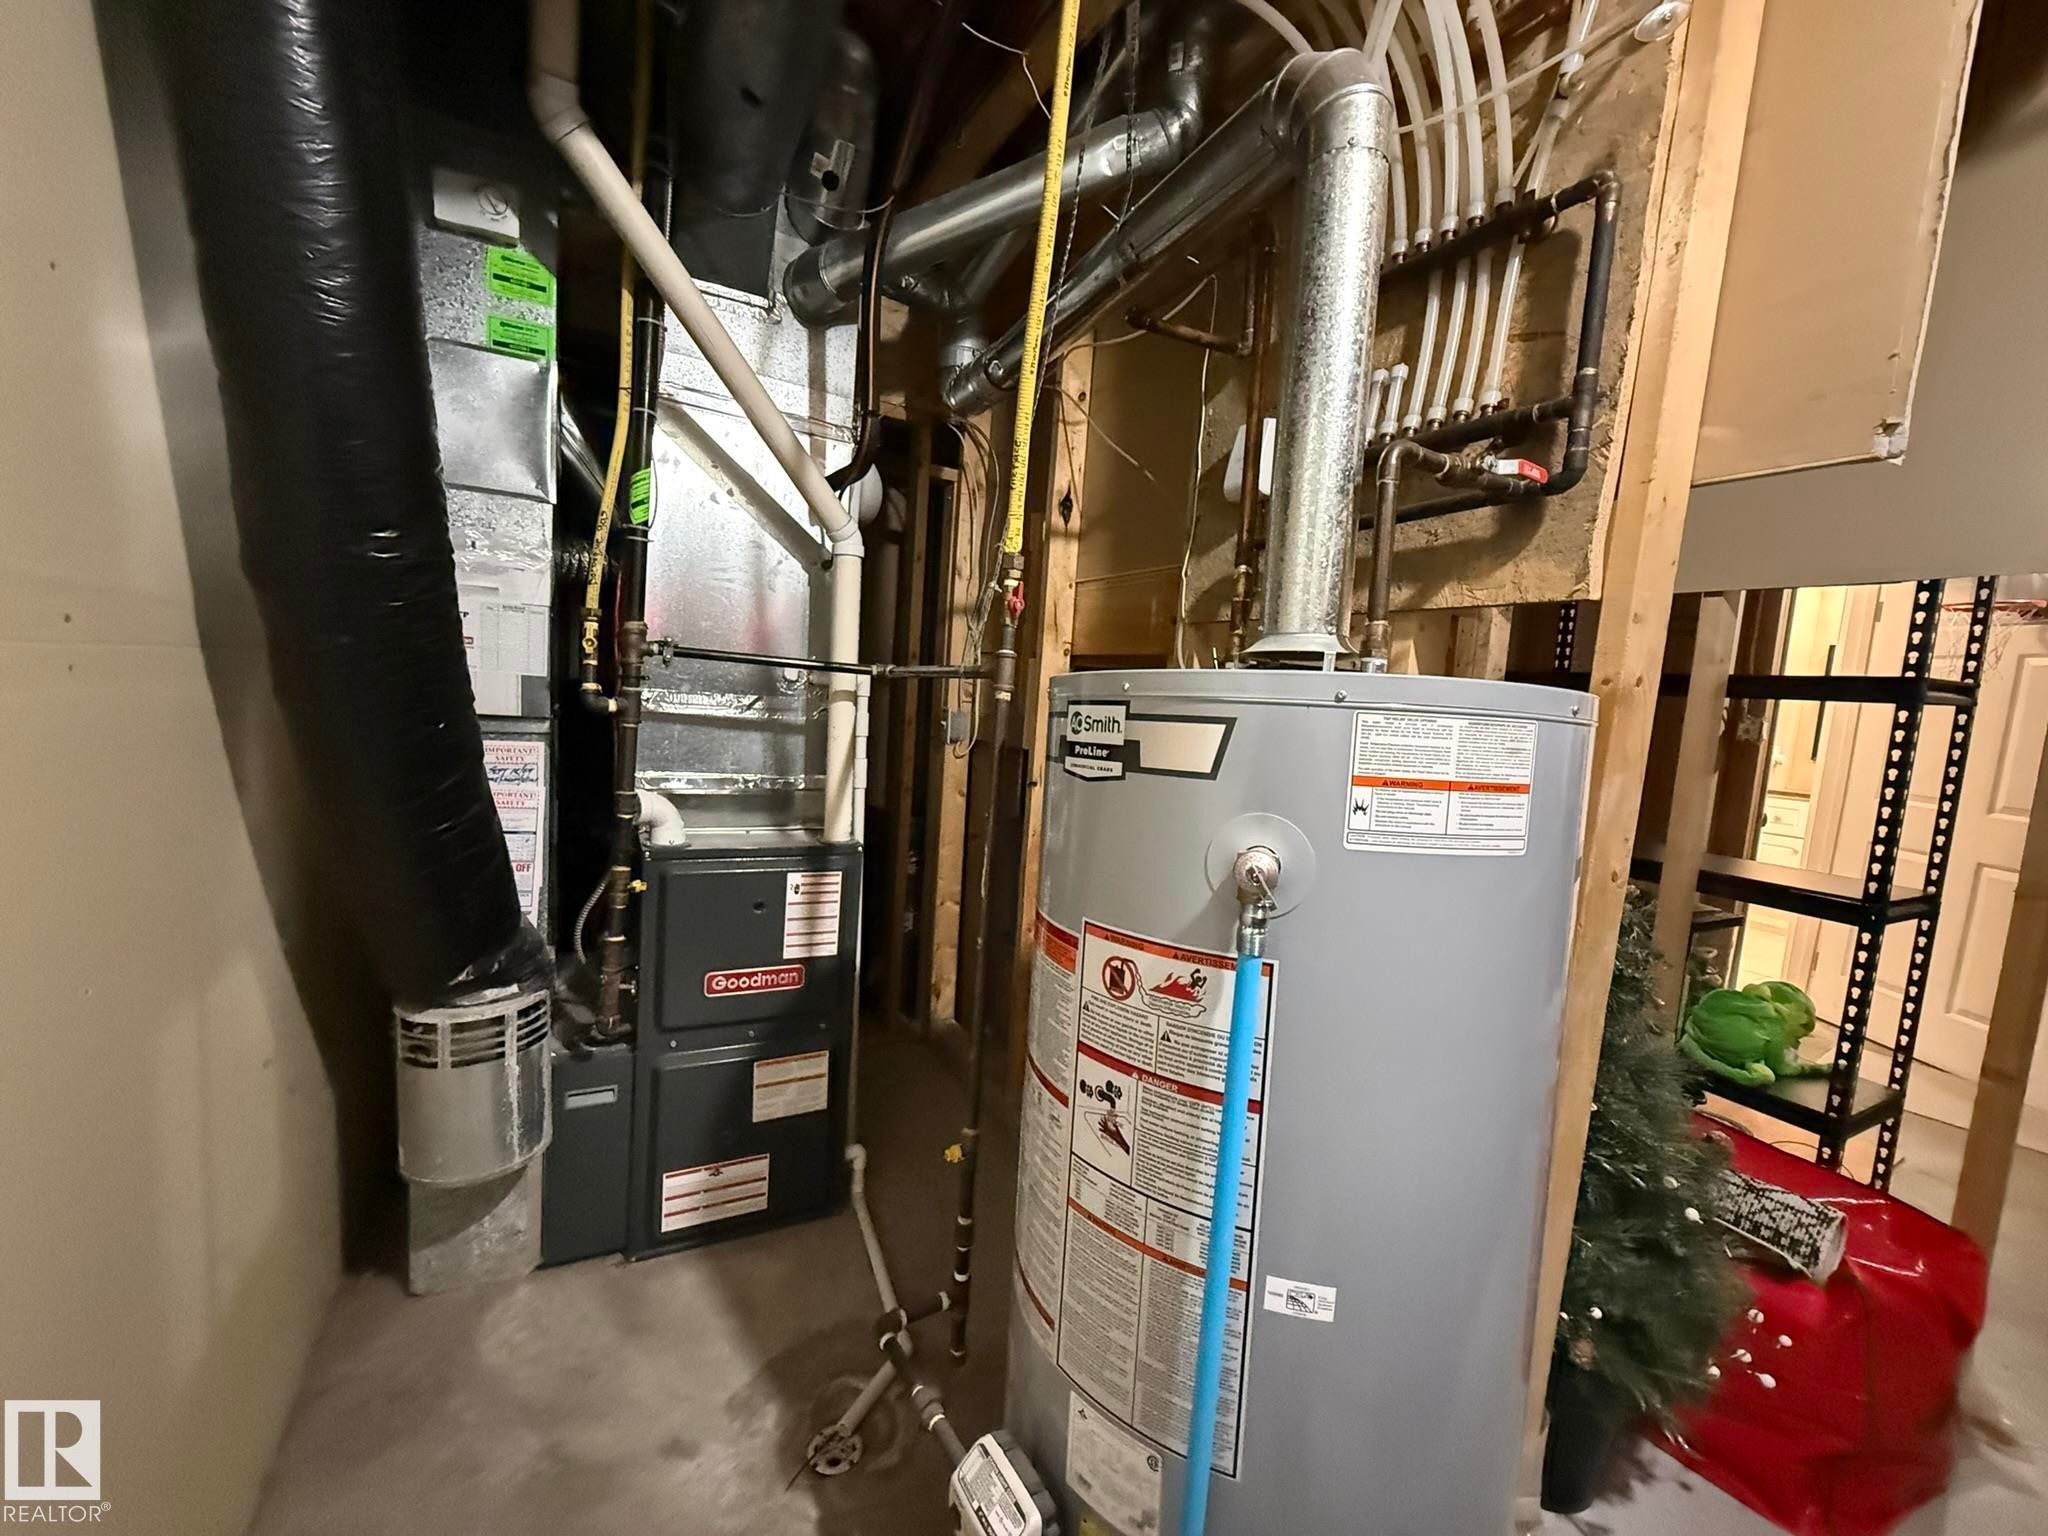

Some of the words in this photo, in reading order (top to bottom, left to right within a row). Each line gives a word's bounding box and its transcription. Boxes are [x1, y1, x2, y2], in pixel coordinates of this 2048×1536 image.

[1084, 715, 1121, 733] Smith
[1074, 745, 1109, 757] ProLine
[1389, 781, 1424, 789] WARNING
[515, 863, 532, 873] OFF
[1180, 953, 1237, 971] AVERTISSEM
[712, 973, 799, 991] Goodman
[1142, 1074, 1178, 1092] DANGER
